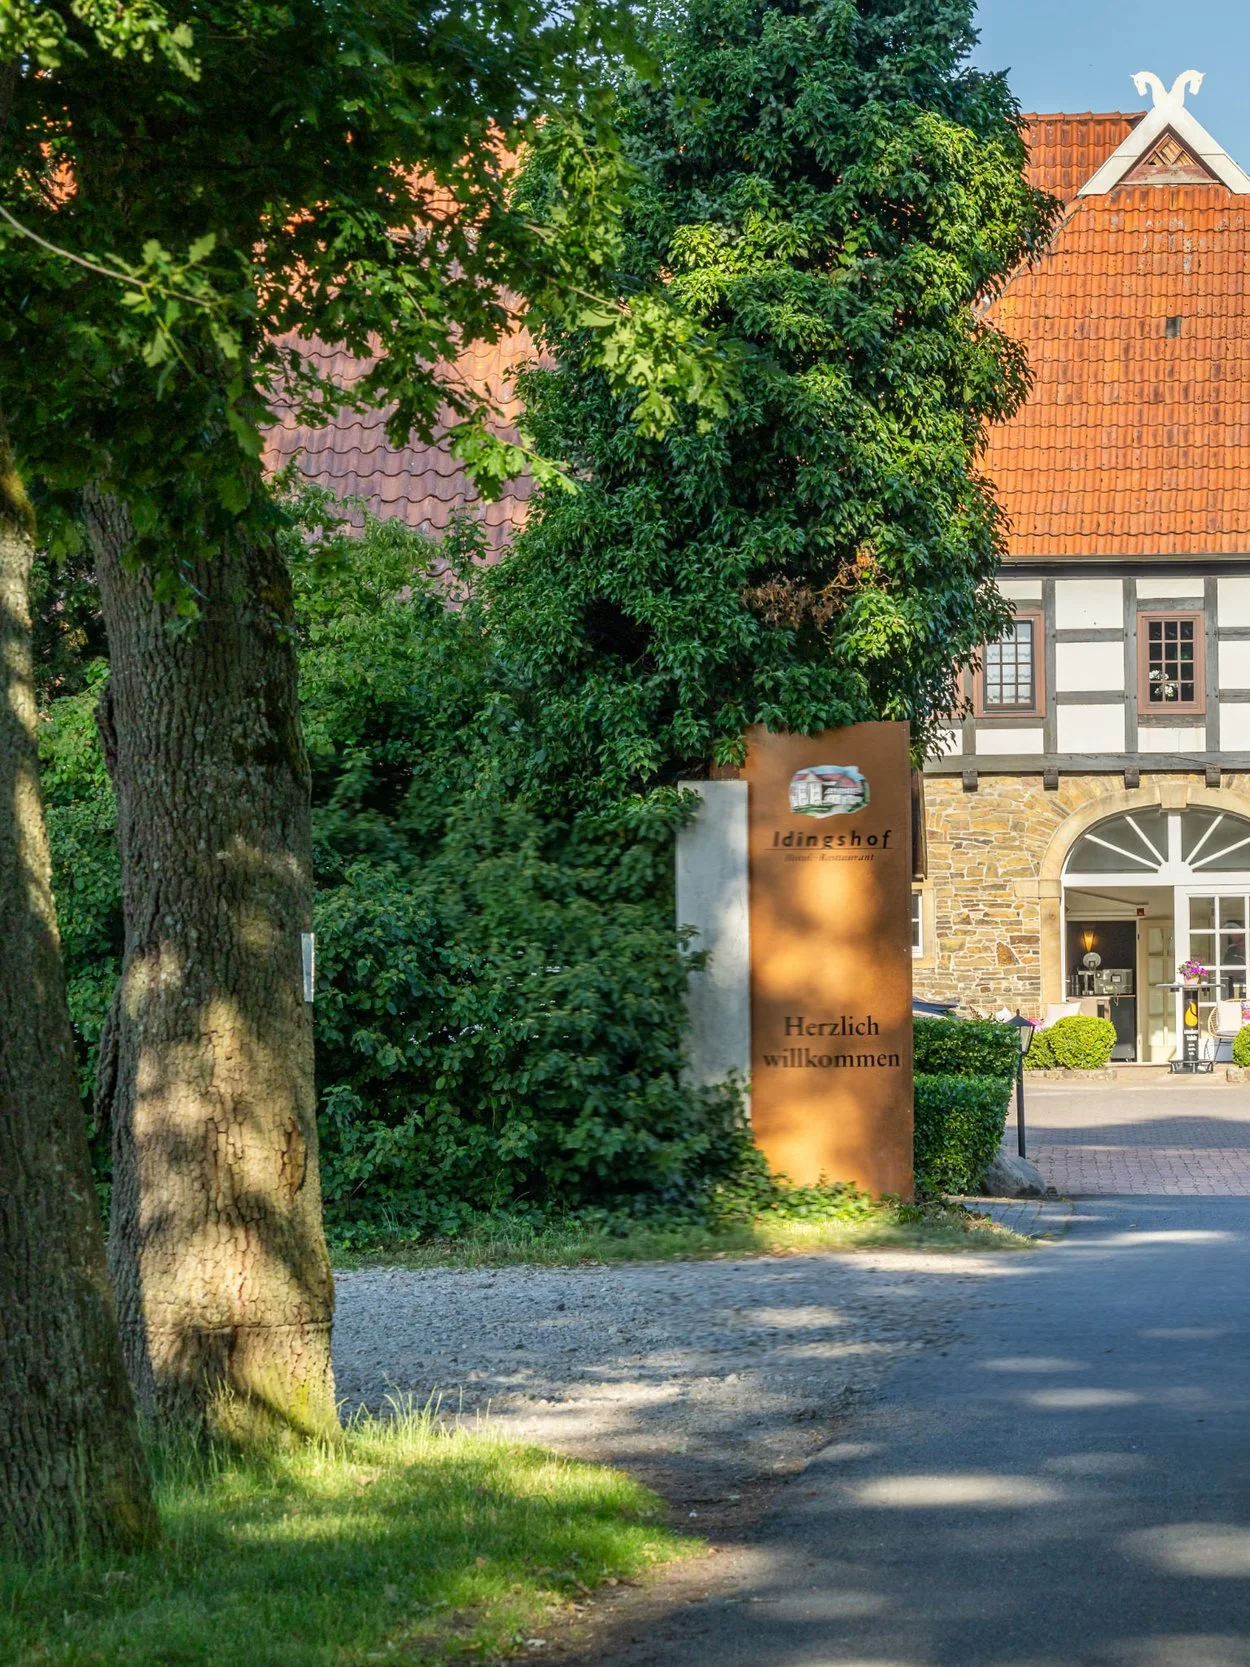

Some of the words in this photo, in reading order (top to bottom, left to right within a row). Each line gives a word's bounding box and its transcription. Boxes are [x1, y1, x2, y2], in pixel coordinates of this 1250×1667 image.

[772, 830, 892, 849] Idingshof
[784, 1015, 880, 1036] Herzlich
[763, 1048, 901, 1068] willkommen
